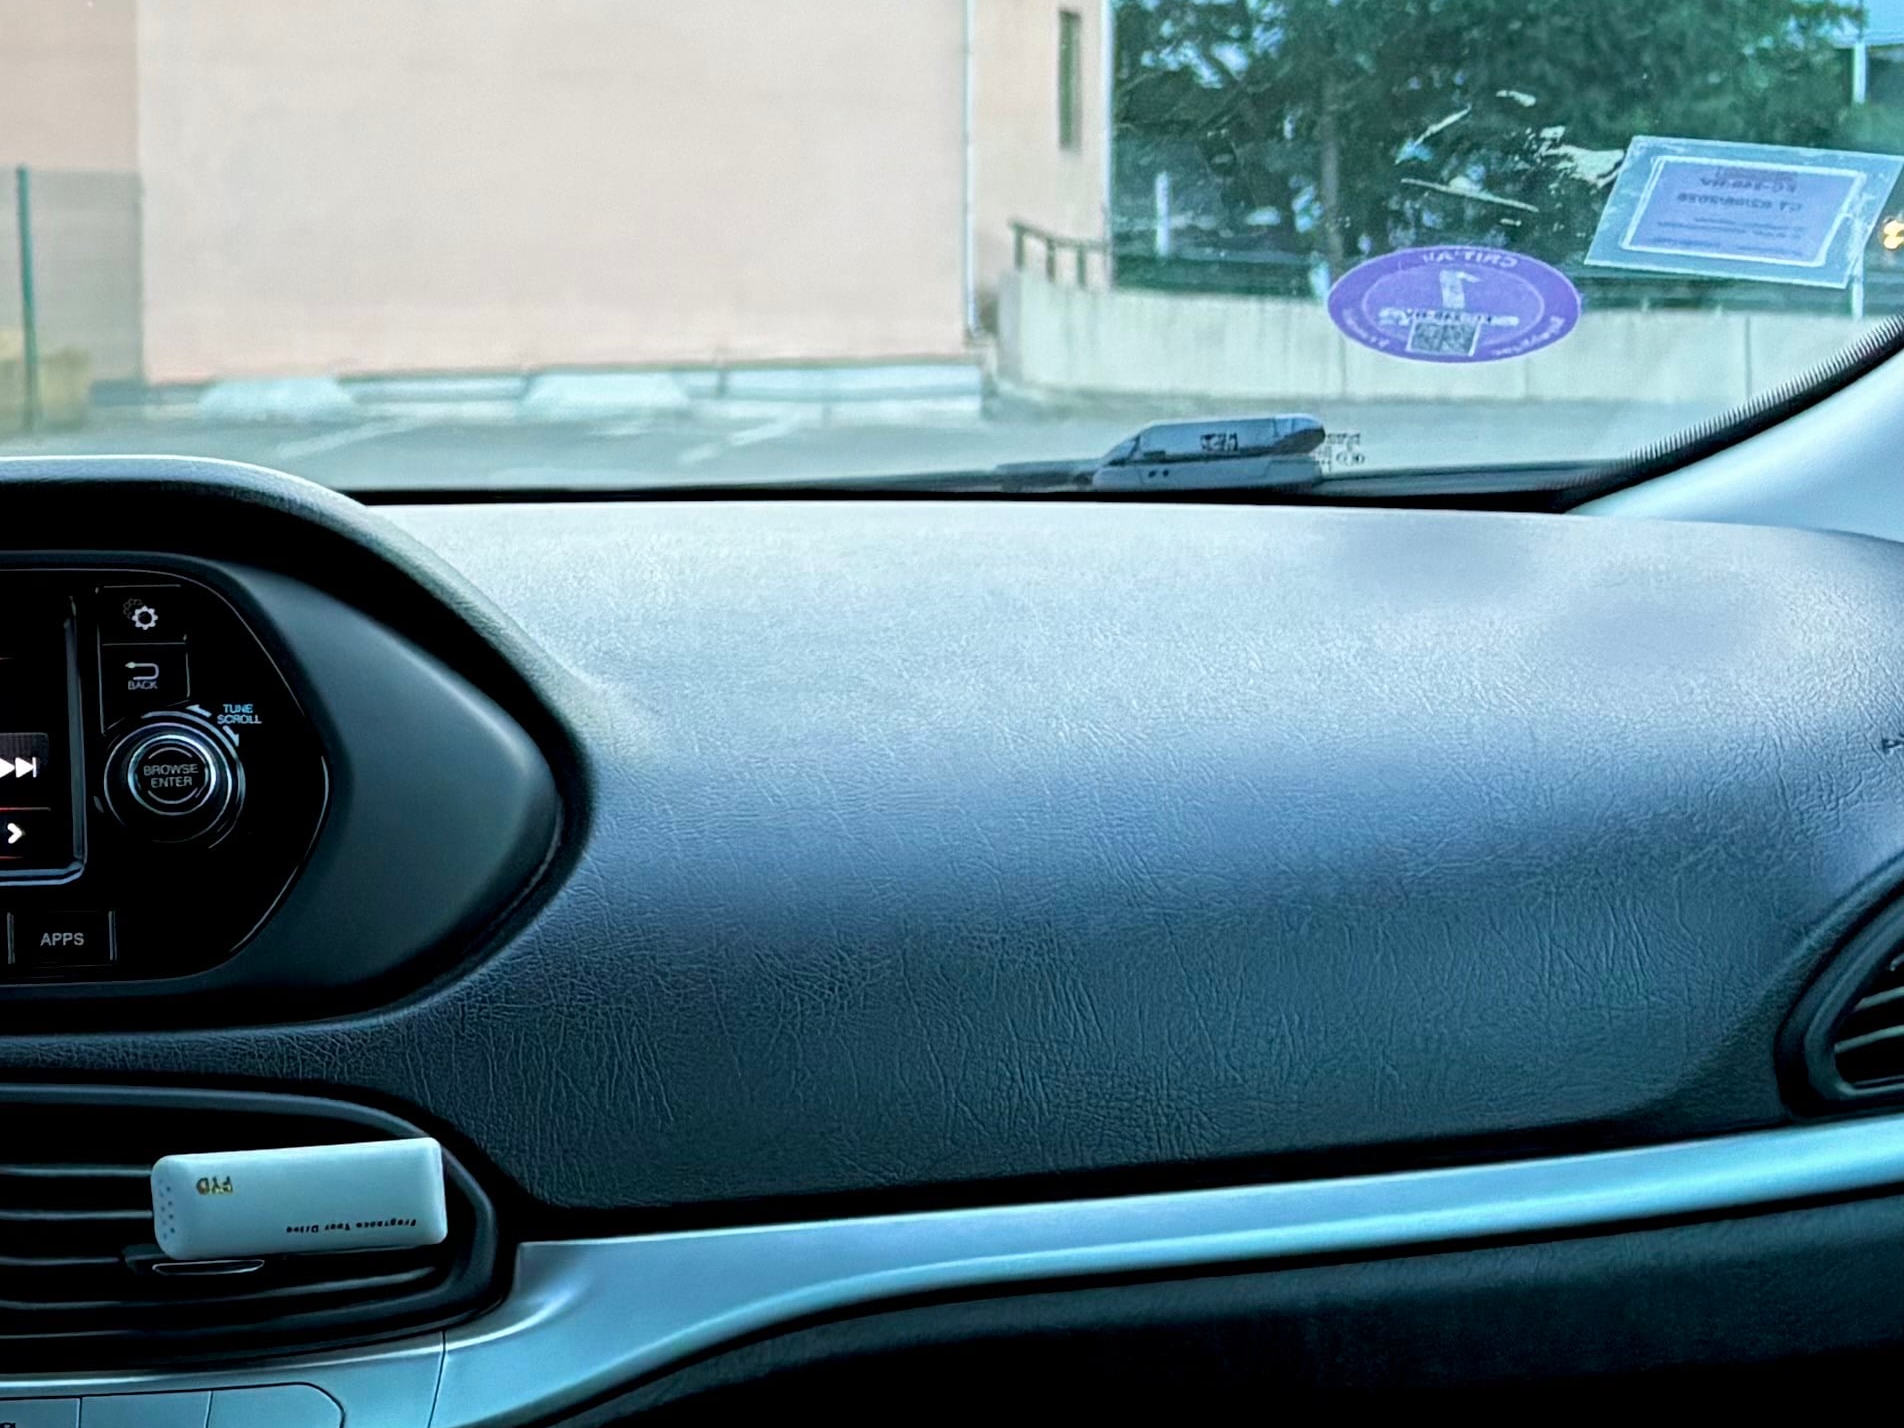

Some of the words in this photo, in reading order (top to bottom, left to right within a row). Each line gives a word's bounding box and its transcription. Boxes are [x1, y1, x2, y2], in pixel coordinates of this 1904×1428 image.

[128, 681, 158, 690] BACK
[222, 703, 253, 714] TUNE
[217, 714, 263, 724] SCROLL
[143, 764, 199, 776] BROWSE
[150, 776, 193, 789] ENTER
[40, 932, 85, 947] APPS
[196, 1176, 233, 1195] FYD
